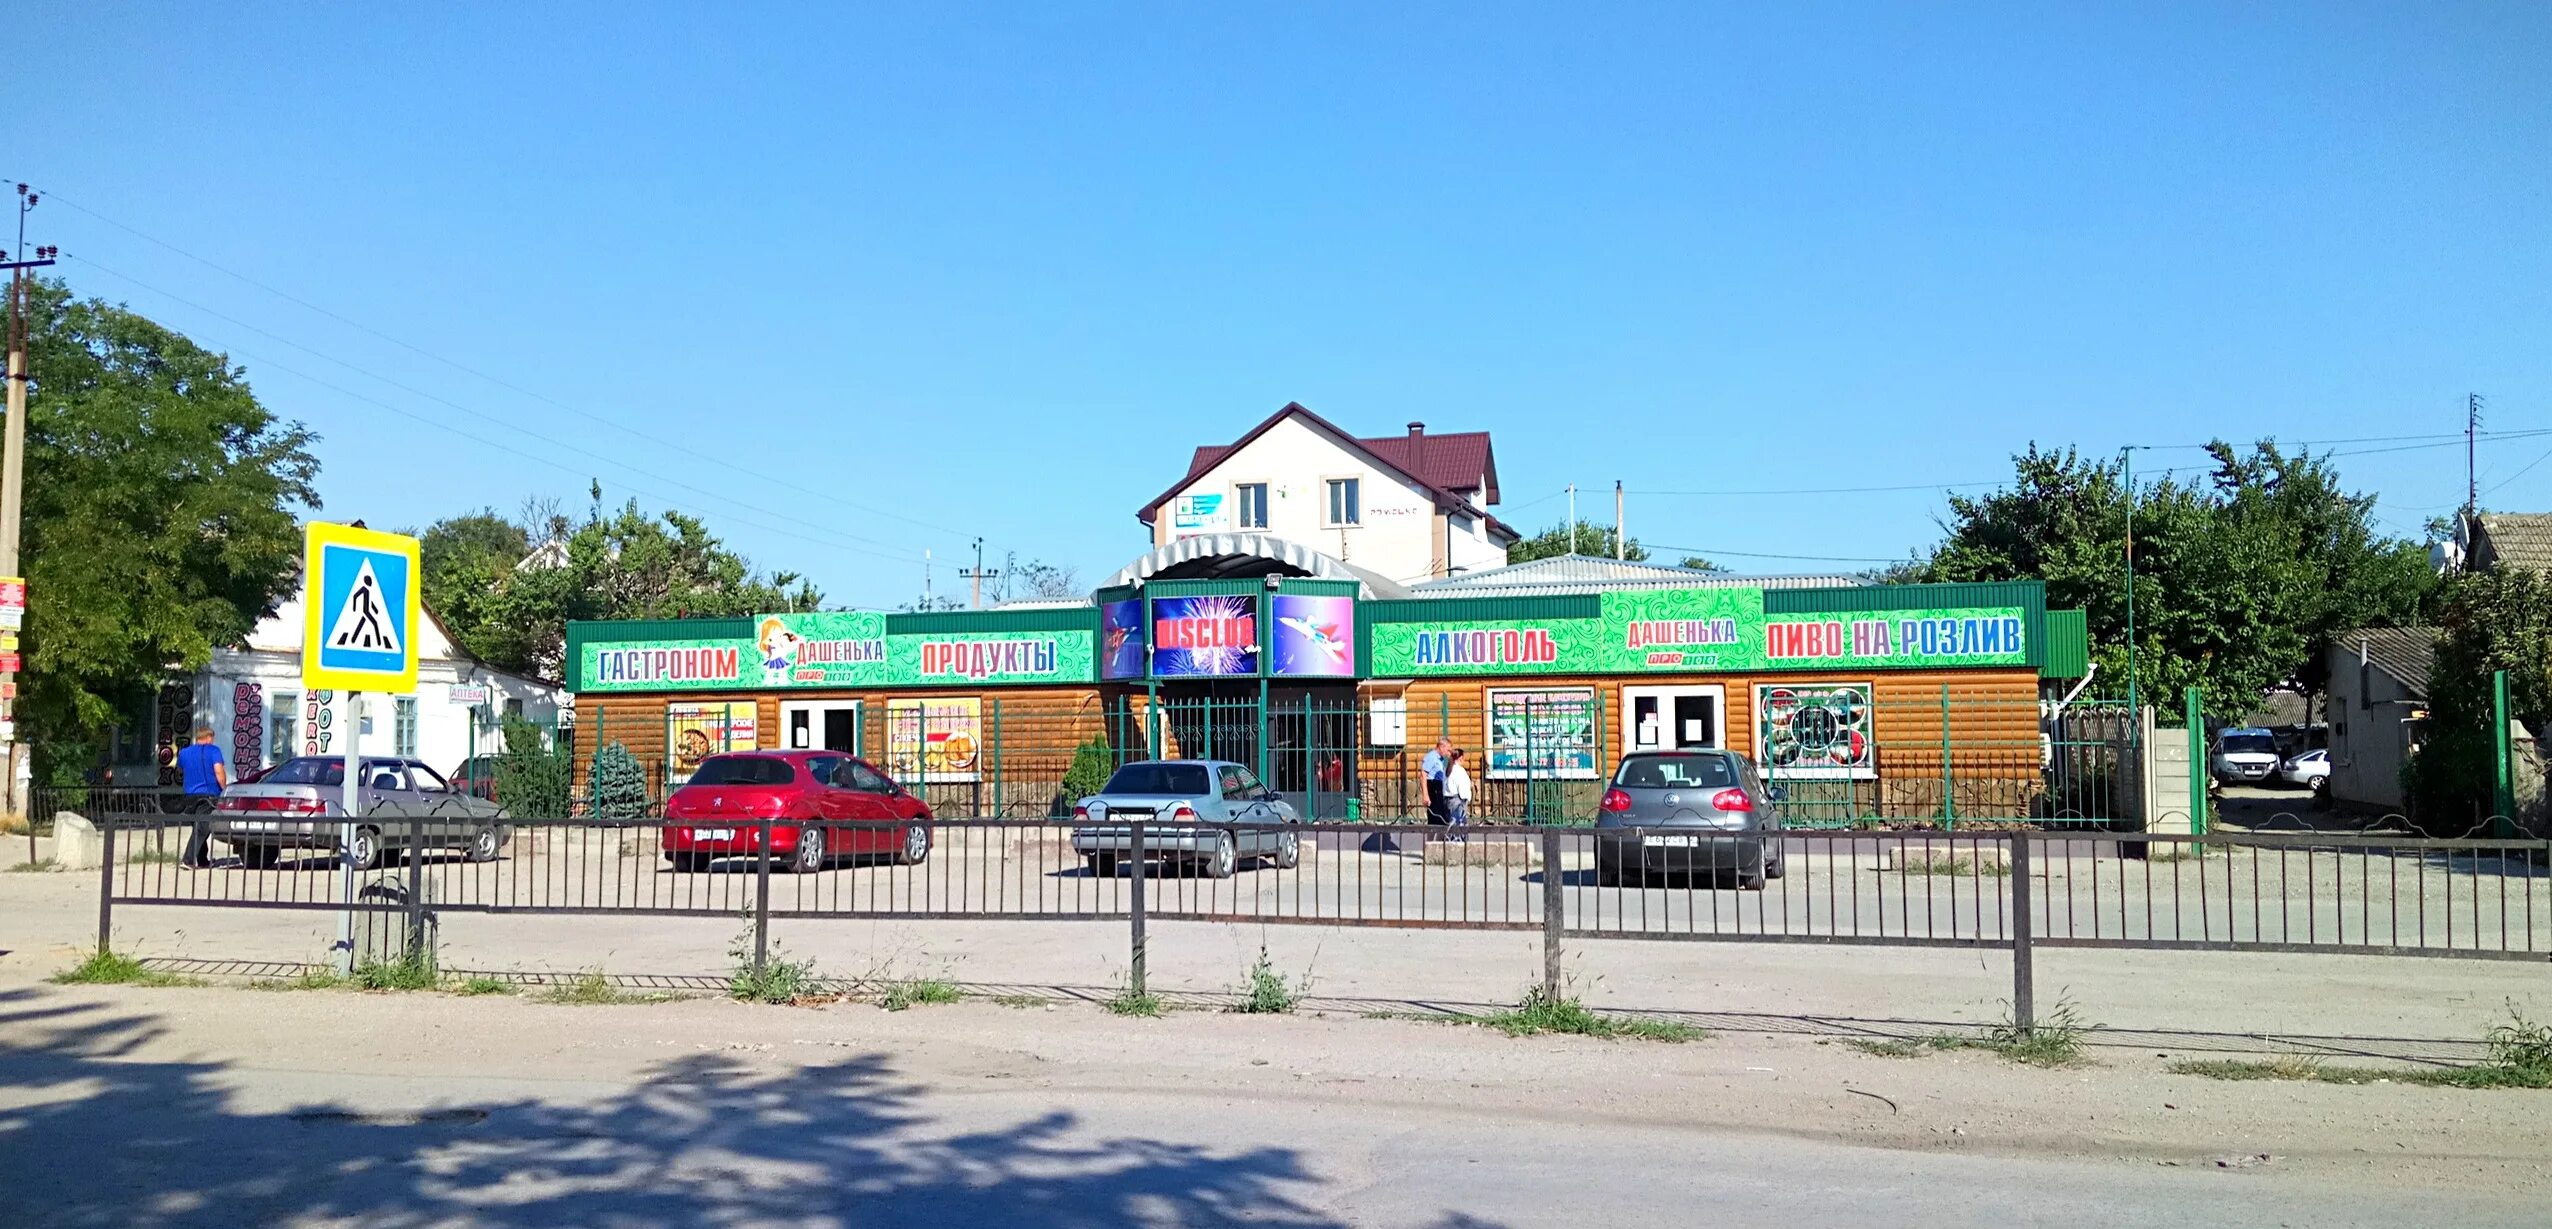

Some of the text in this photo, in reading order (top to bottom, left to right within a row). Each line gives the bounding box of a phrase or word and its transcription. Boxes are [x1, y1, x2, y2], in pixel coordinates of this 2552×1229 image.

[1156, 616, 1254, 649] DISCLUB
[1417, 630, 1556, 664] АЛКОГОЛЬ
[1628, 620, 1736, 648] ДАШЕНЬКА
[1767, 617, 2020, 658] ПИВО НА РОЗЛИВ
[600, 648, 737, 681] ГАСТРОНОМ
[796, 640, 884, 665] ДАШЕНЬКА
[922, 641, 1055, 678] ПРОДУКТЫ
[450, 687, 484, 699] АПТЕКА
[306, 688, 319, 757] XERO
